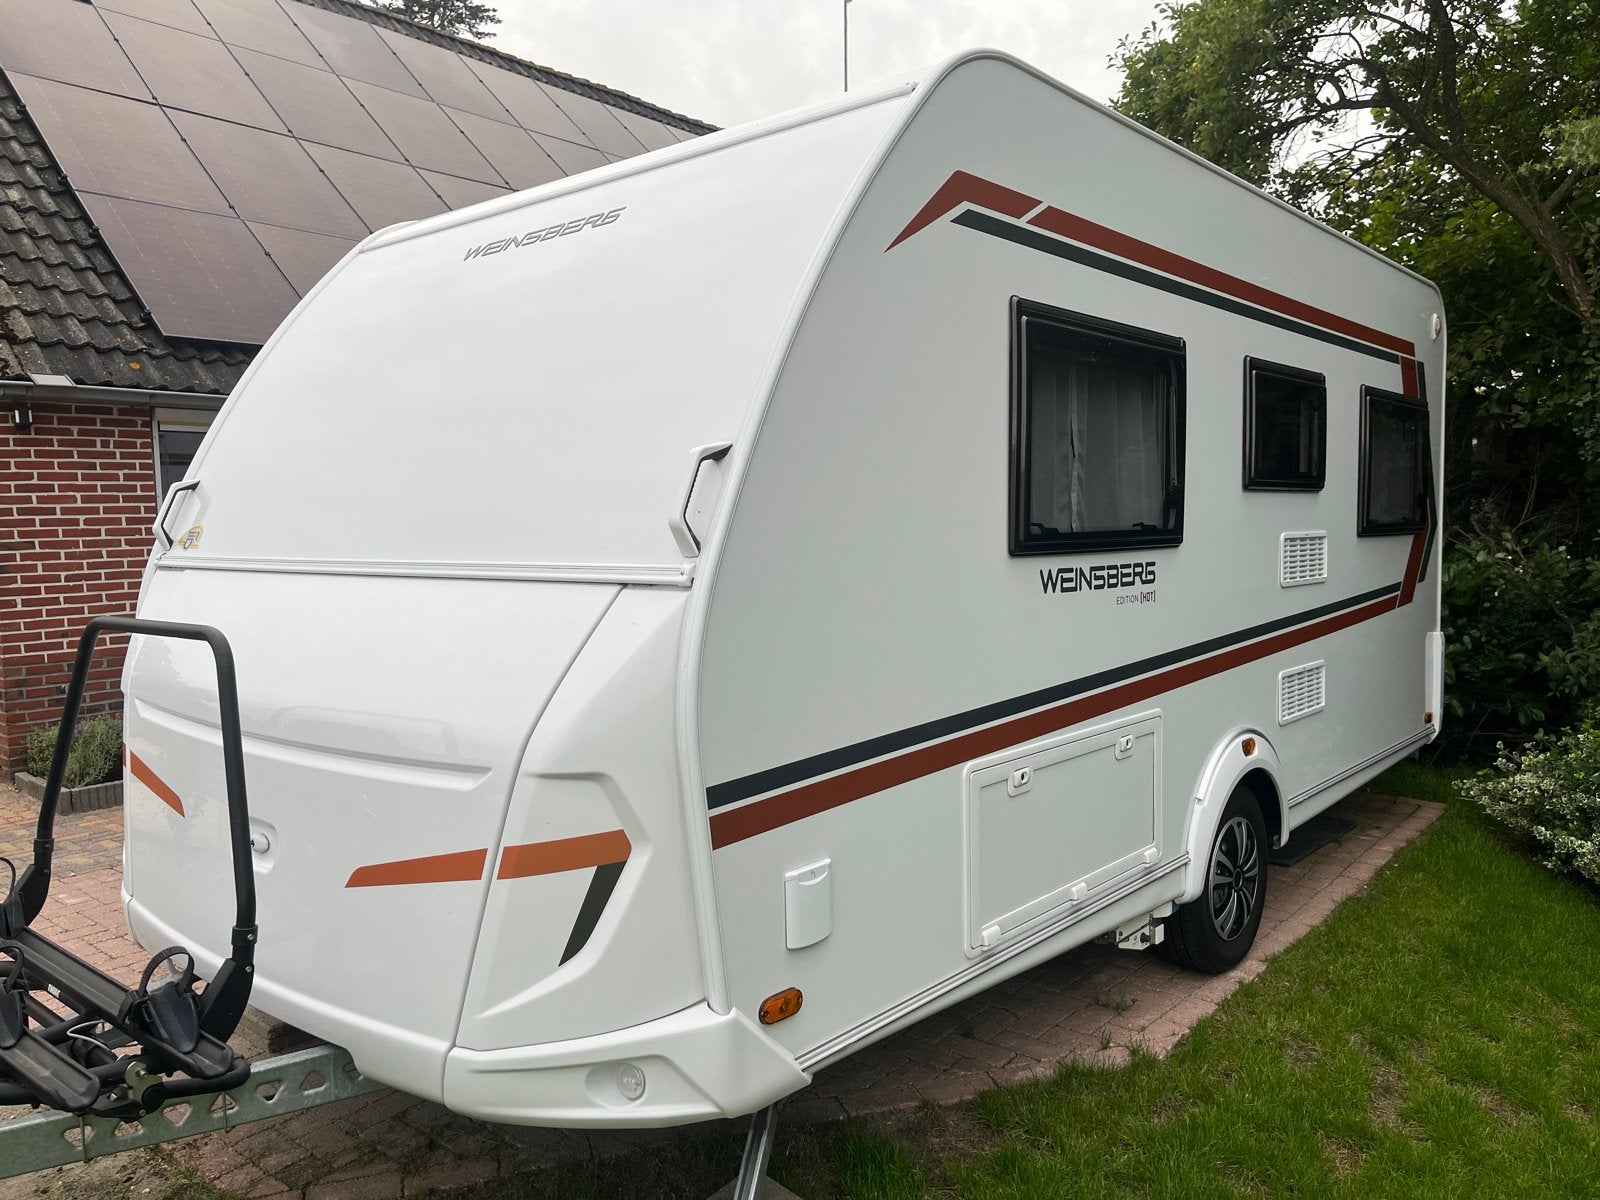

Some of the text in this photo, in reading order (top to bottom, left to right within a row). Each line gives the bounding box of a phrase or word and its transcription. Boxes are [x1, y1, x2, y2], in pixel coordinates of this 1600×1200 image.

[463, 206, 627, 261] WEINSBERG
[1040, 561, 1156, 594] WEINSBERG
[1116, 594, 1139, 605] EDITION
